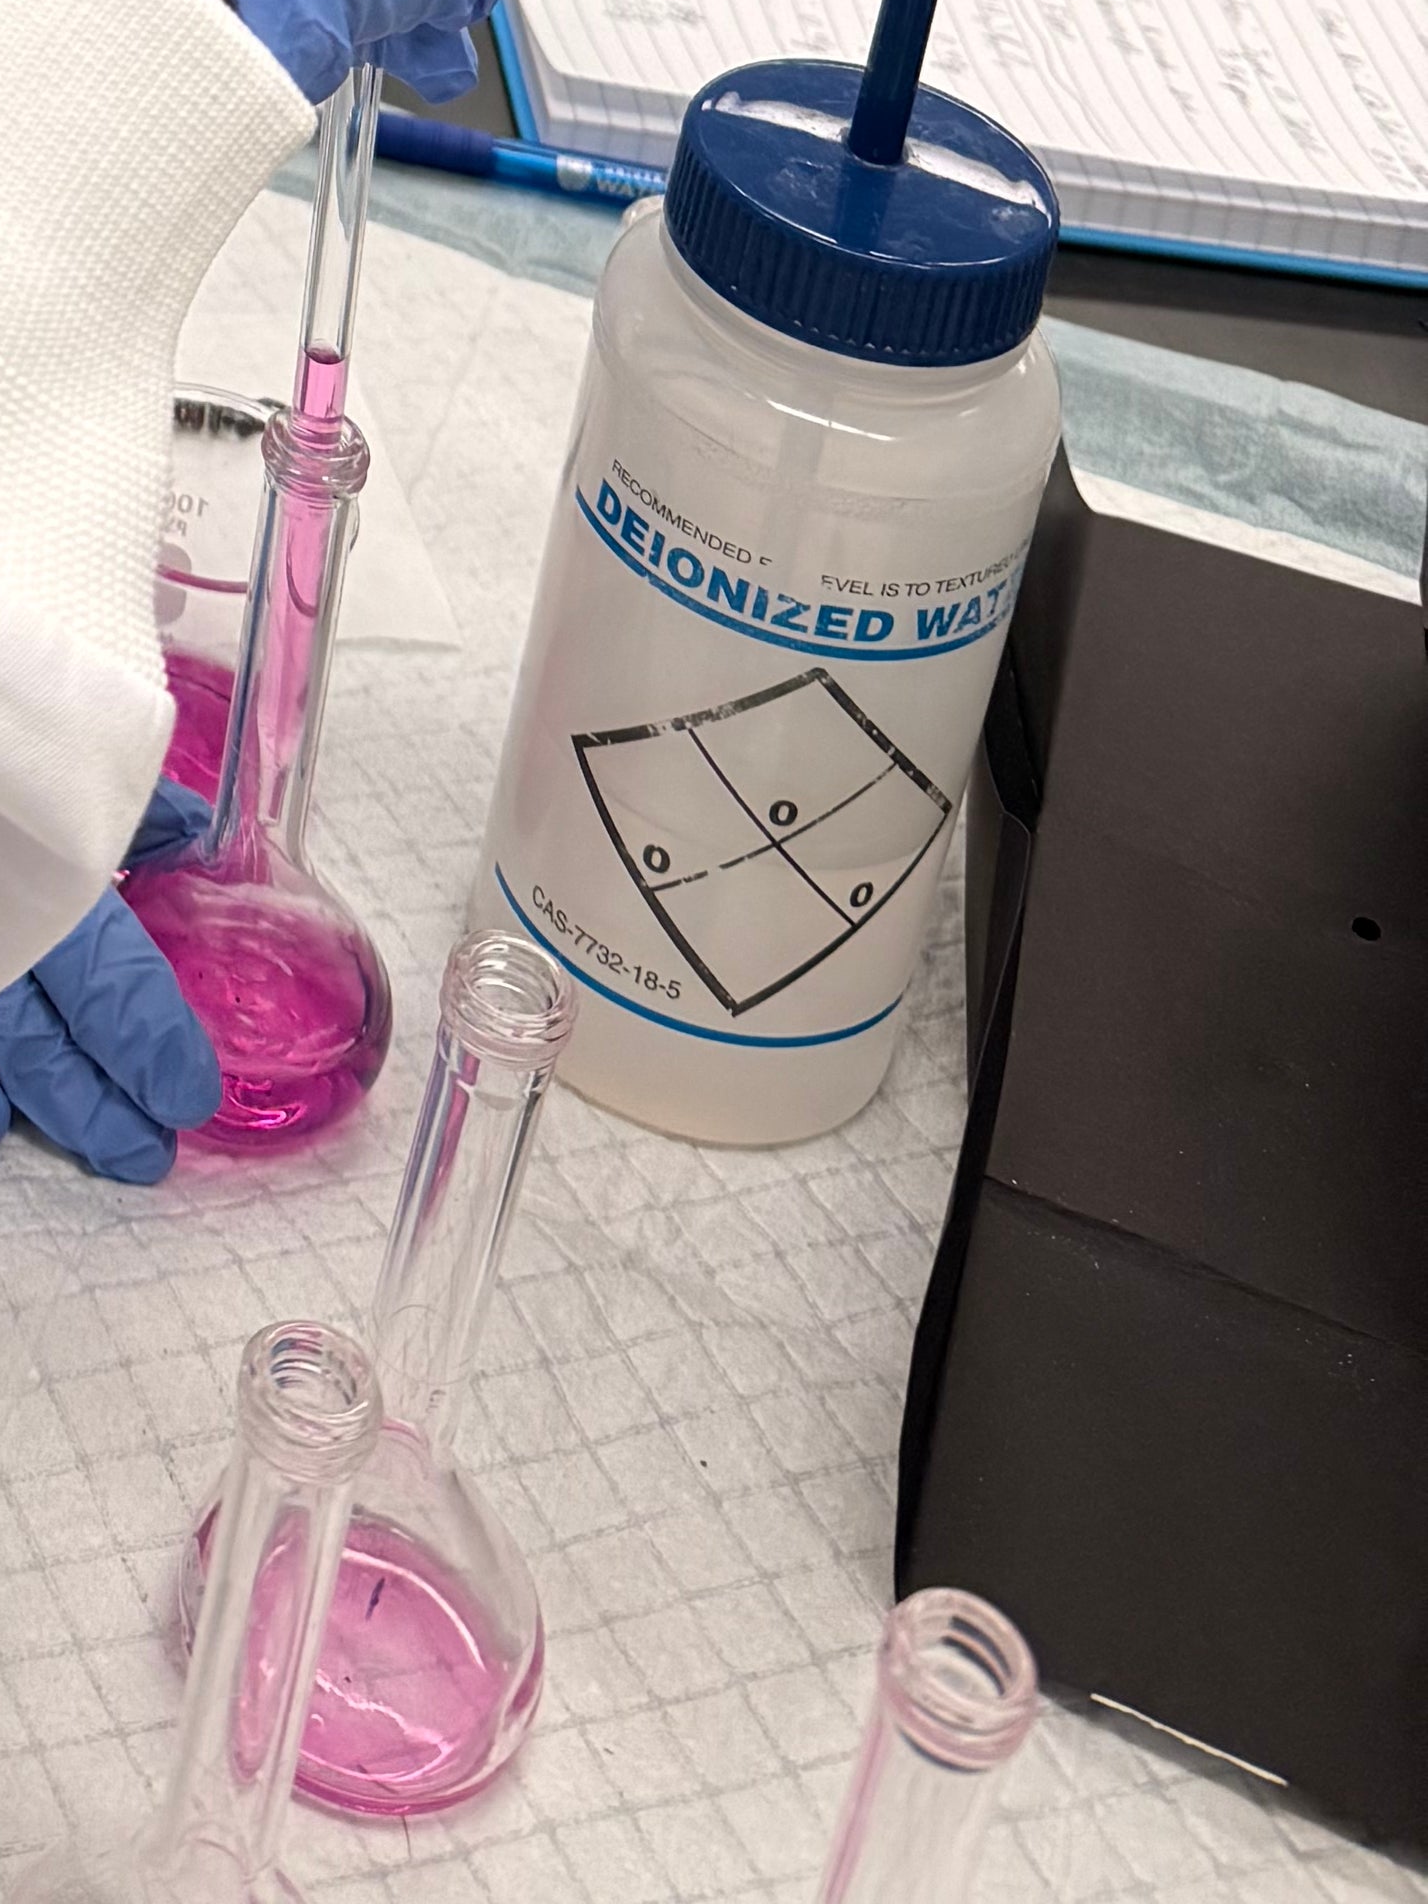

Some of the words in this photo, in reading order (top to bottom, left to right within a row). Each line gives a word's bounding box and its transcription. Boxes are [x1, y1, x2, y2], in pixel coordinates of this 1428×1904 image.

[597, 477, 895, 642] DEIONIZED
[611, 458, 752, 565] RECOMMENDED
[880, 583, 900, 597] IS
[905, 582, 931, 597] TO
[532, 884, 682, 1000] CAS-7732-18-5
